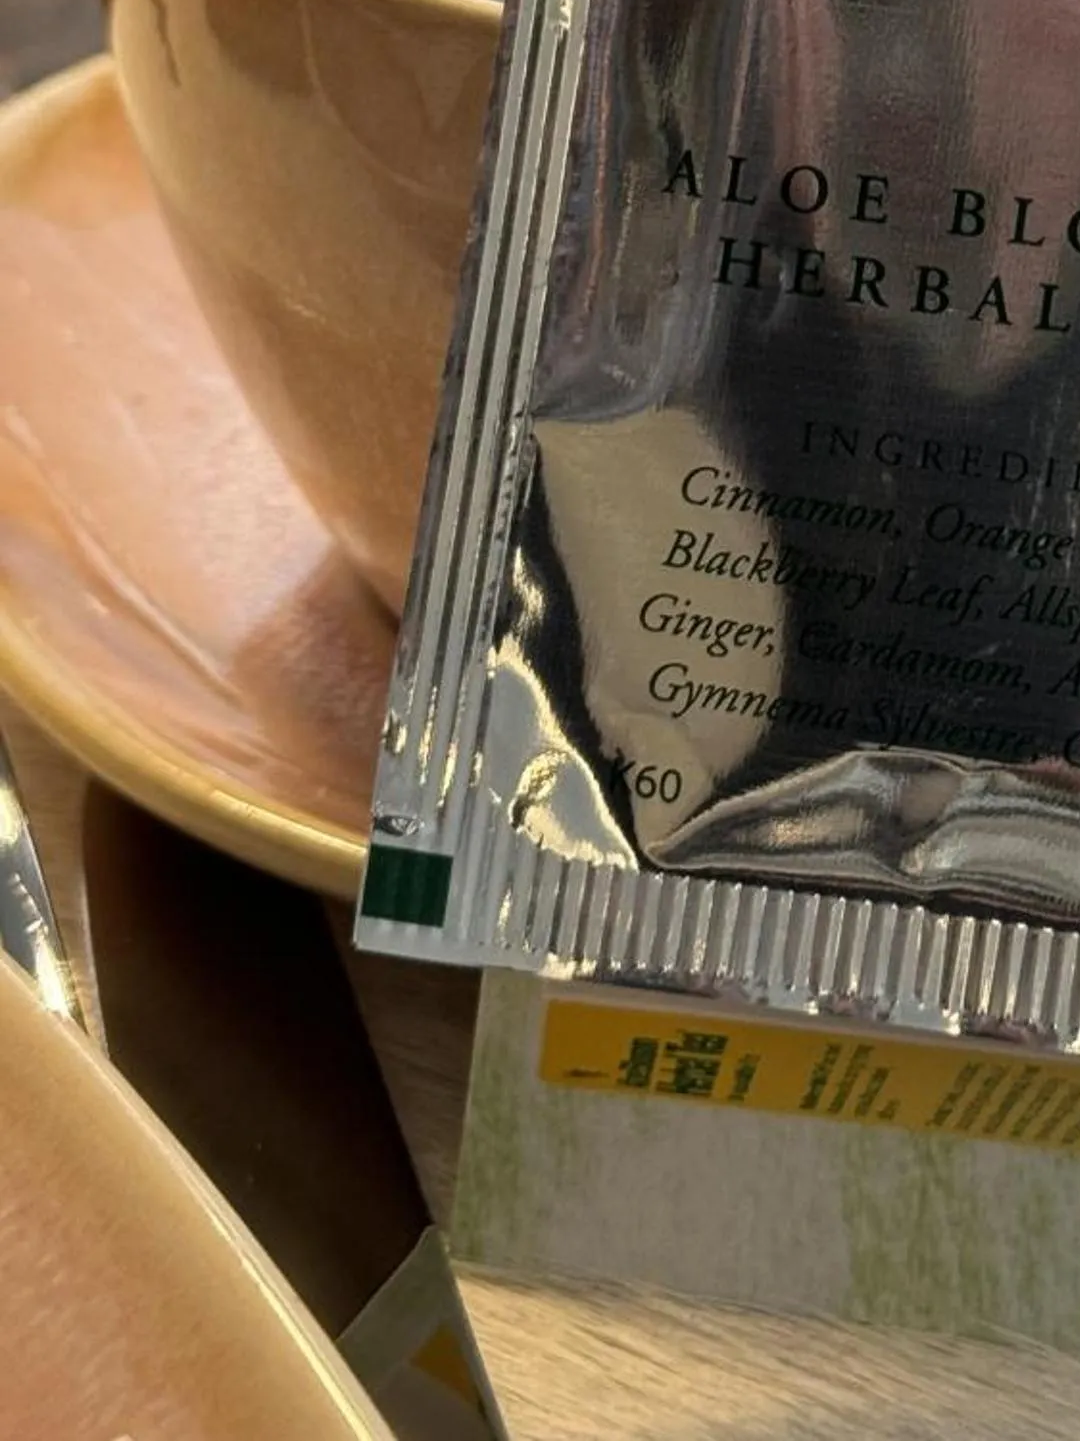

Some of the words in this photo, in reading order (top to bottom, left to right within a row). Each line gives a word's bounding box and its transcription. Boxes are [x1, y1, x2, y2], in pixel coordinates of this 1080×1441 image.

[662, 149, 890, 224] ALOE
[712, 235, 1072, 333] HERBAL
[681, 466, 902, 539] Cinnamon,
[925, 502, 1073, 571] Orange
[662, 528, 878, 611] Blackberry
[888, 564, 984, 627] Leaf,
[638, 592, 776, 658] Ginger,
[798, 620, 1032, 695] Cardamom,
[648, 662, 849, 730] Gymnema
